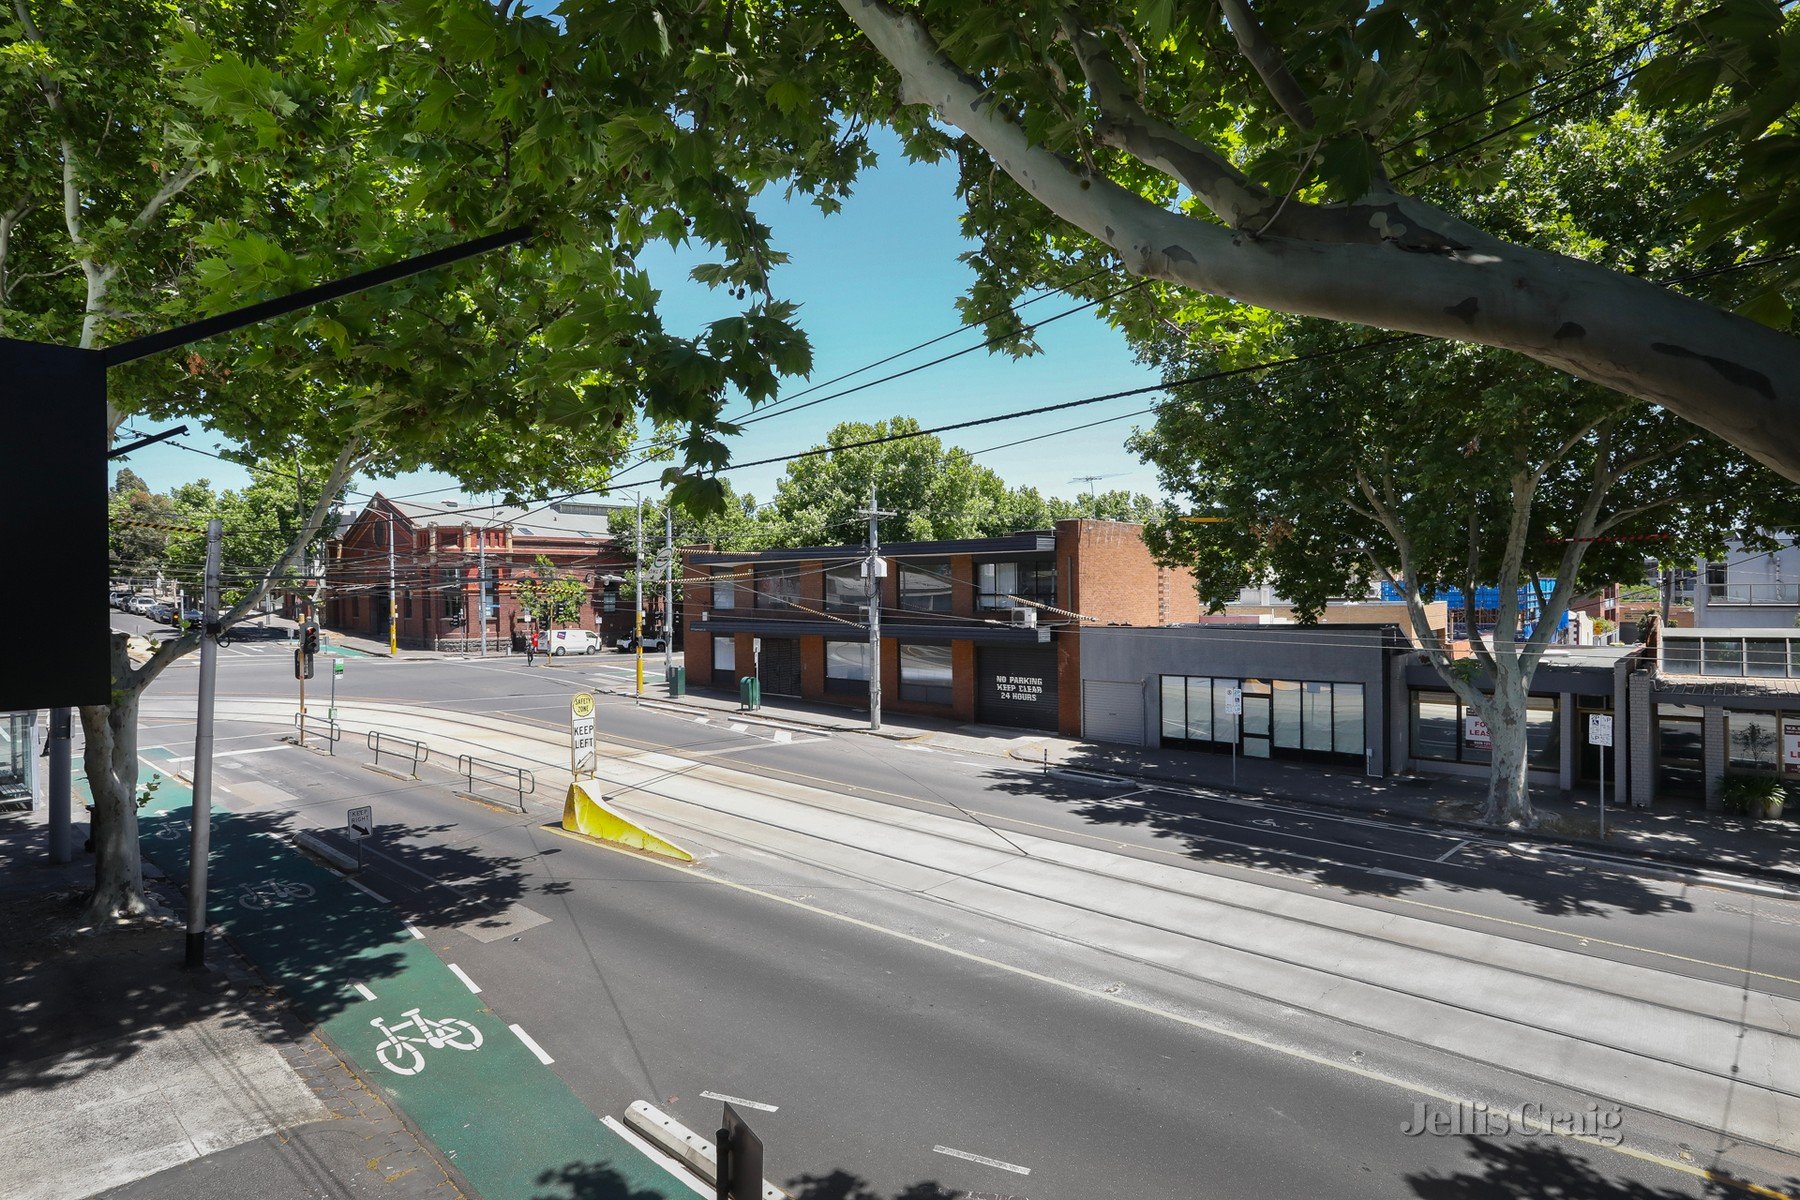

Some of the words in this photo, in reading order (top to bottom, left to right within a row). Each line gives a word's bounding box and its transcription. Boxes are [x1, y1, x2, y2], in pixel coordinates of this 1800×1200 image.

[996, 675, 1007, 683] NO
[1009, 676, 1043, 686] PARKING
[996, 683, 1016, 692] KEEP
[1018, 685, 1043, 694] CLEAR
[1000, 692, 1010, 700] 24
[1012, 692, 1037, 702] HOURS
[577, 705, 589, 713] ZONE
[574, 724, 595, 736] KEEP
[1469, 729, 1490, 737] LEAS
[574, 738, 594, 749] LEFT
[351, 809, 368, 817] KEEP
